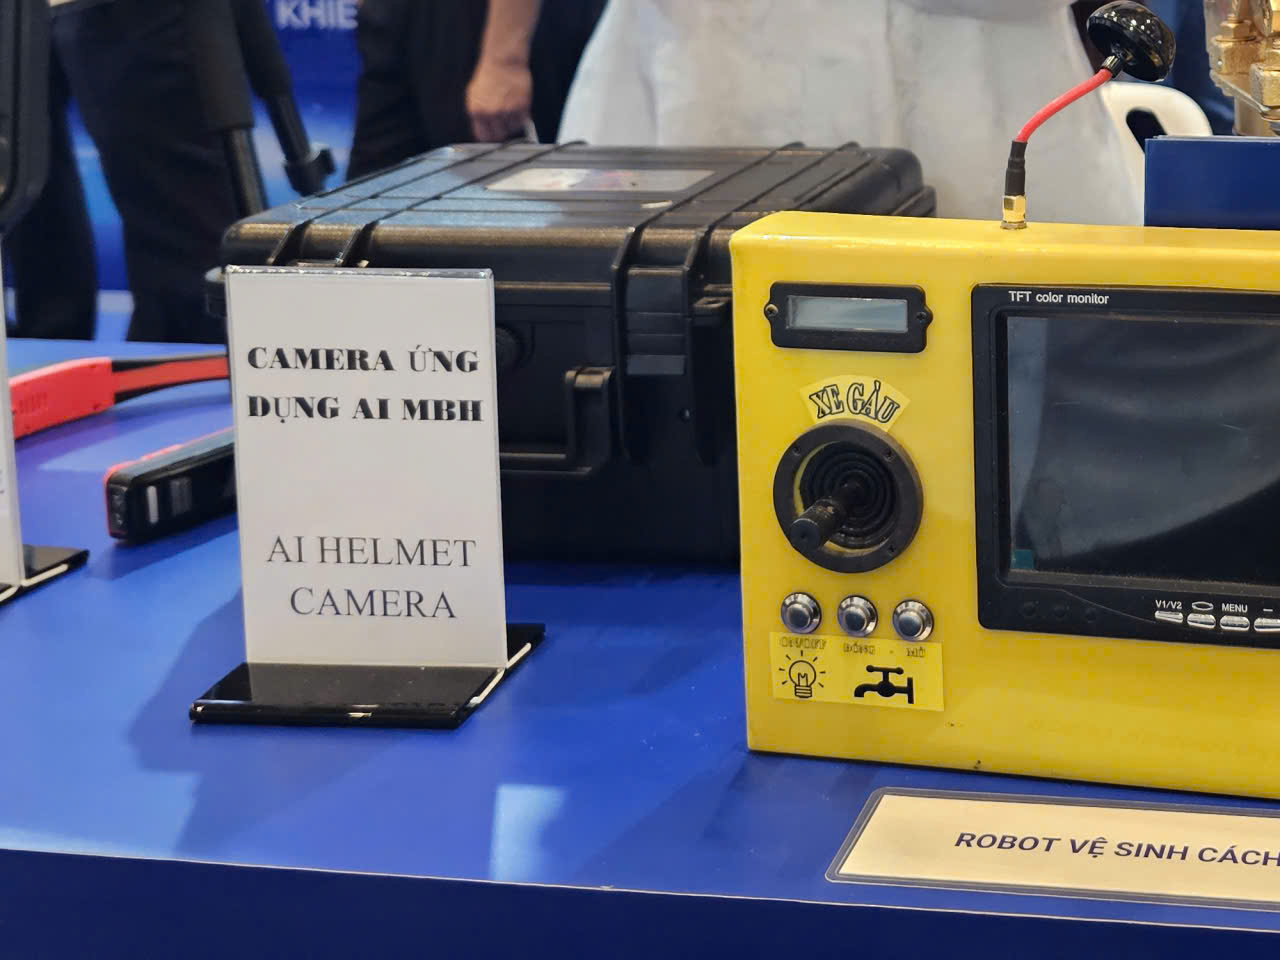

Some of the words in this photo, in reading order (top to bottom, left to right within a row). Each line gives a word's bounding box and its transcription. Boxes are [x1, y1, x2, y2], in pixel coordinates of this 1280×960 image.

[1008, 290, 1032, 302] TFT
[1035, 292, 1063, 303] color
[1067, 293, 1110, 305] monitor
[247, 346, 396, 372] CAMERA
[407, 345, 480, 373] ỨNG
[247, 395, 340, 424] DỤNG
[351, 398, 391, 420] AI
[401, 398, 485, 422] MBH
[808, 383, 845, 419] XE
[266, 536, 305, 563] AI
[317, 536, 477, 567] HELMET
[289, 586, 457, 619] CAMERA
[1155, 600, 1183, 610] V1/V2
[1221, 603, 1248, 613] MENU
[954, 832, 1061, 853] ROBOT
[1069, 836, 1108, 858] VỆ
[1114, 841, 1189, 861] SINH
